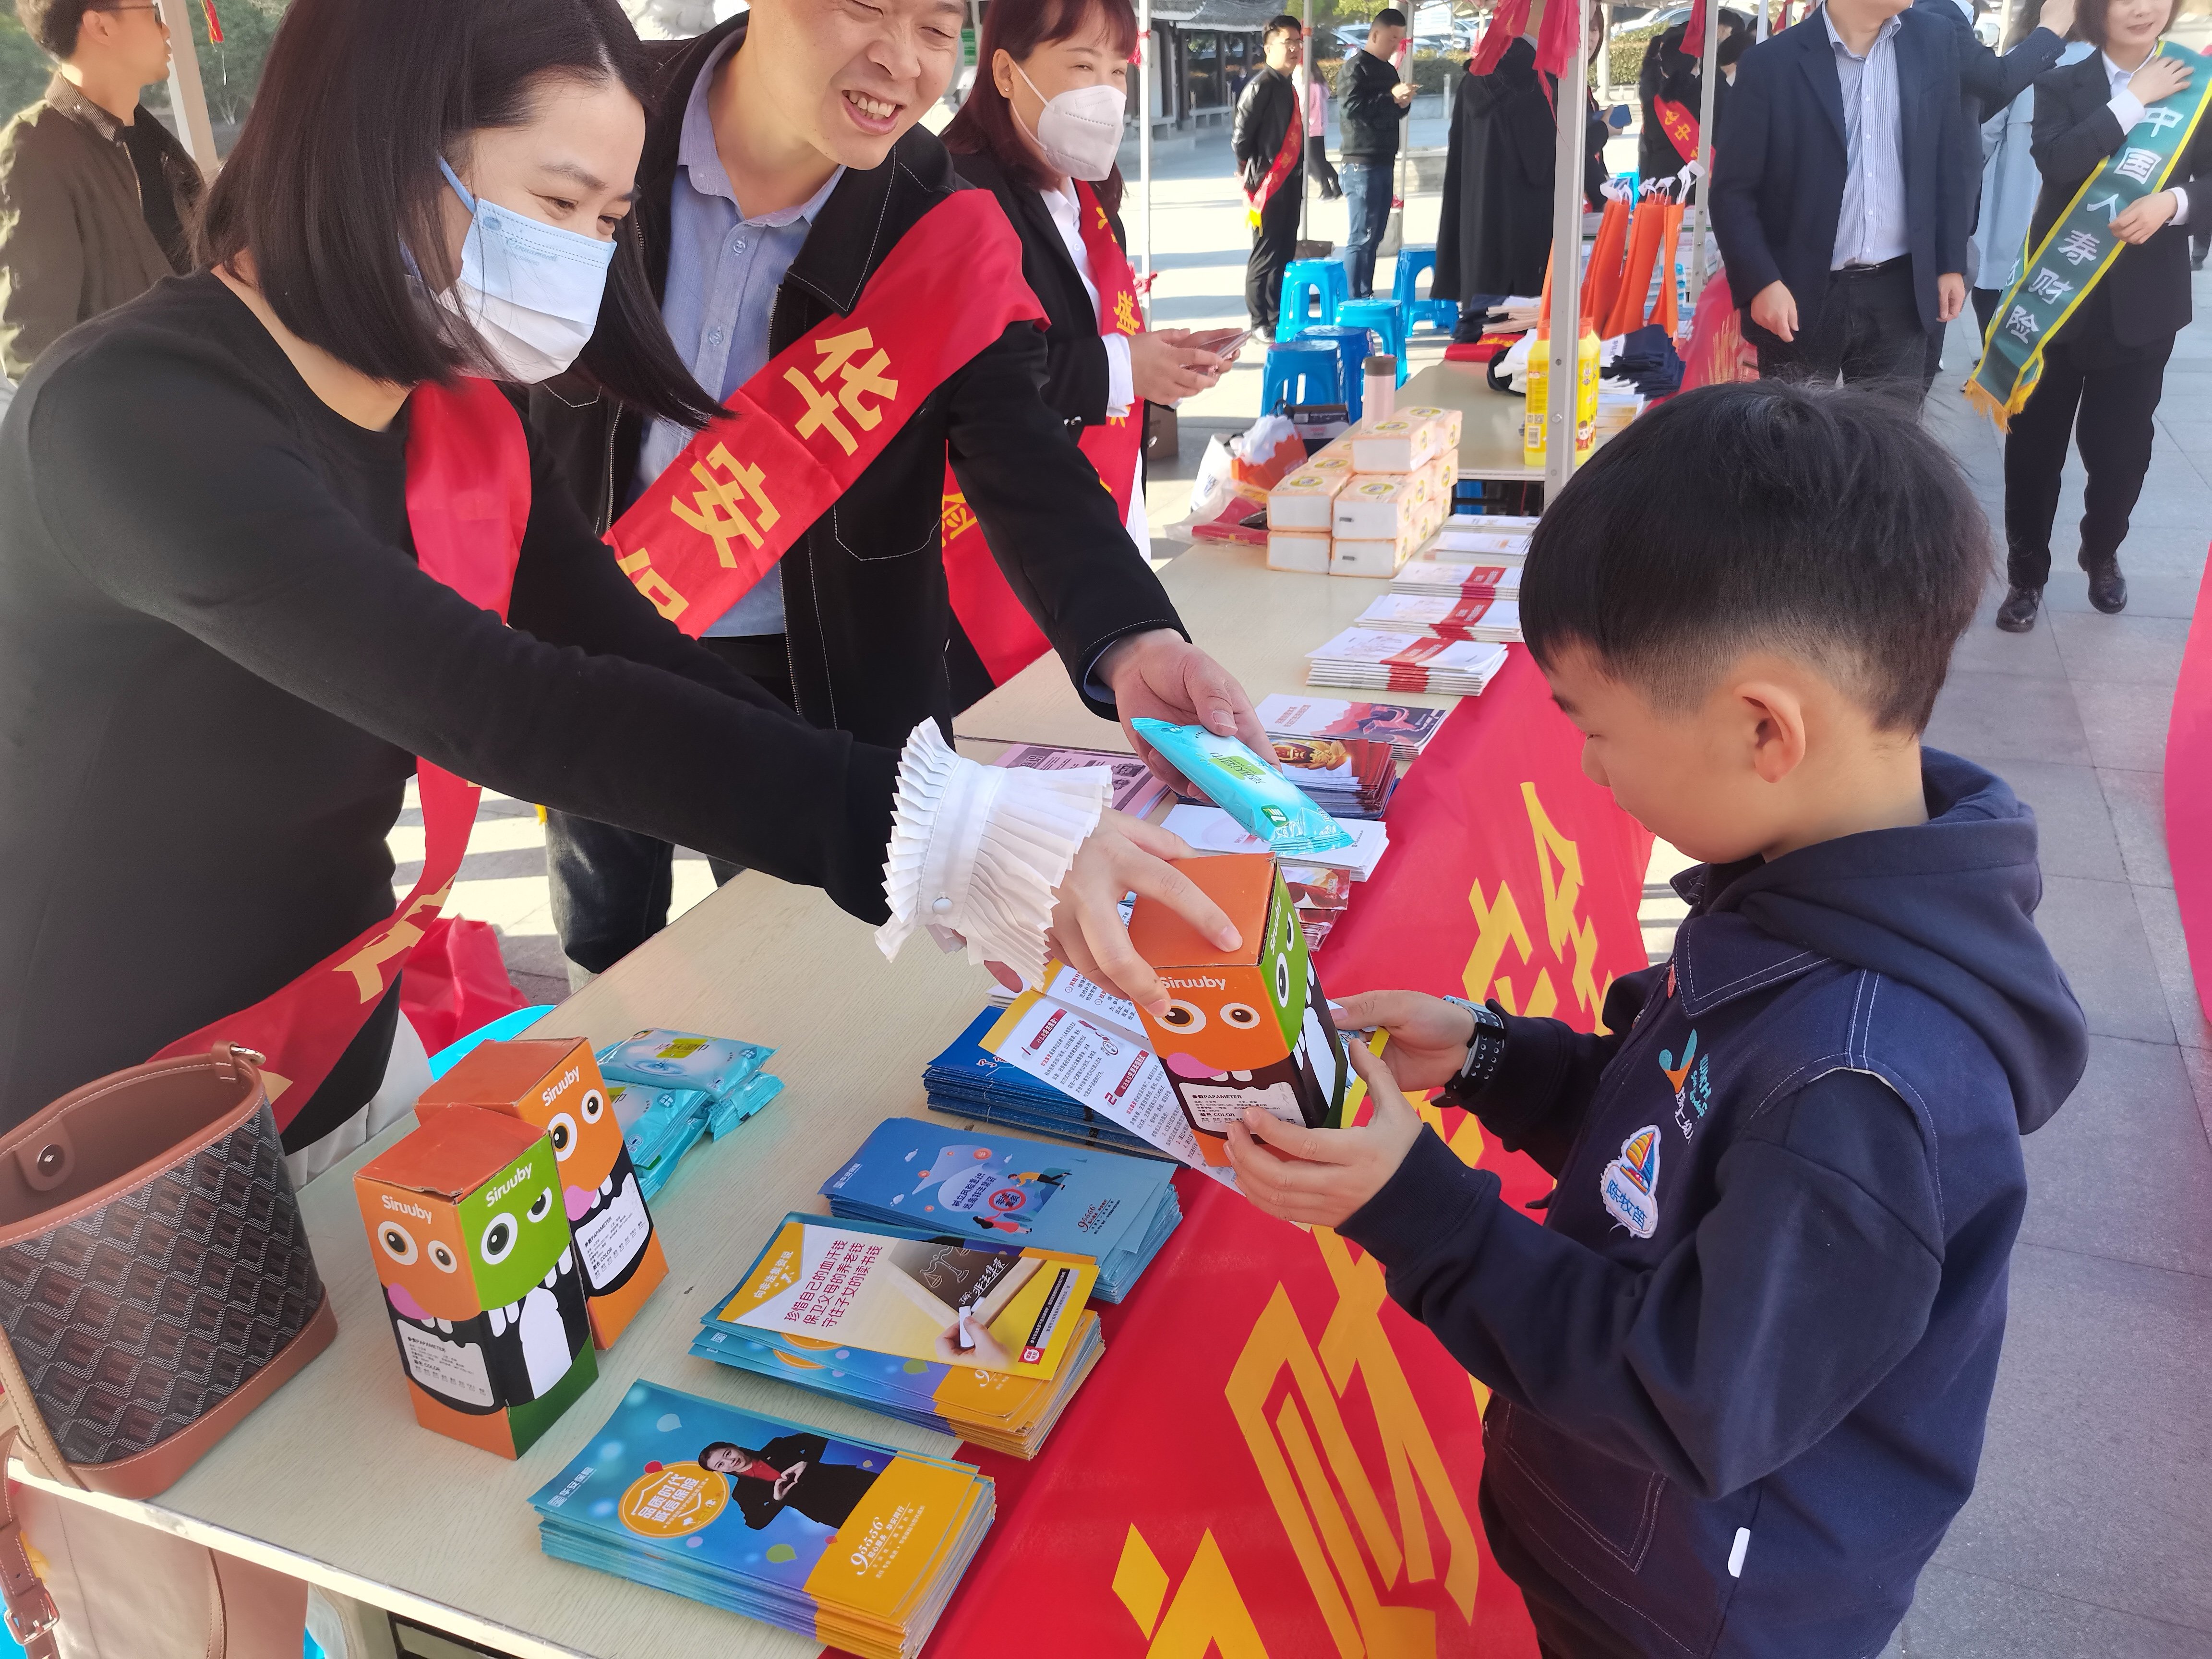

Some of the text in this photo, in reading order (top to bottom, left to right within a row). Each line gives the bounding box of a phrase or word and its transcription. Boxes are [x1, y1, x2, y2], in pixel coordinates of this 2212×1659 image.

[2005, 106, 2184, 344] 中国人寿财险
[542, 1066, 580, 1107] Siruuby
[1105, 1092, 1118, 1105] 2
[486, 1163, 534, 1208] Siruuby
[382, 1195, 433, 1225] Siruuby
[754, 1250, 793, 1298] 向非法集资说
[784, 1239, 848, 1322] 珍惜自己的血汗钱
[802, 1242, 866, 1325] 保卫父母的养老钱
[821, 1245, 883, 1328] 守住子女的读书钱
[638, 1474, 686, 1519] 品质时代
[653, 1478, 699, 1523] 诚信保险
[851, 1517, 883, 1575] 95556
[867, 1505, 904, 1559] 贴心服务 华安同行
